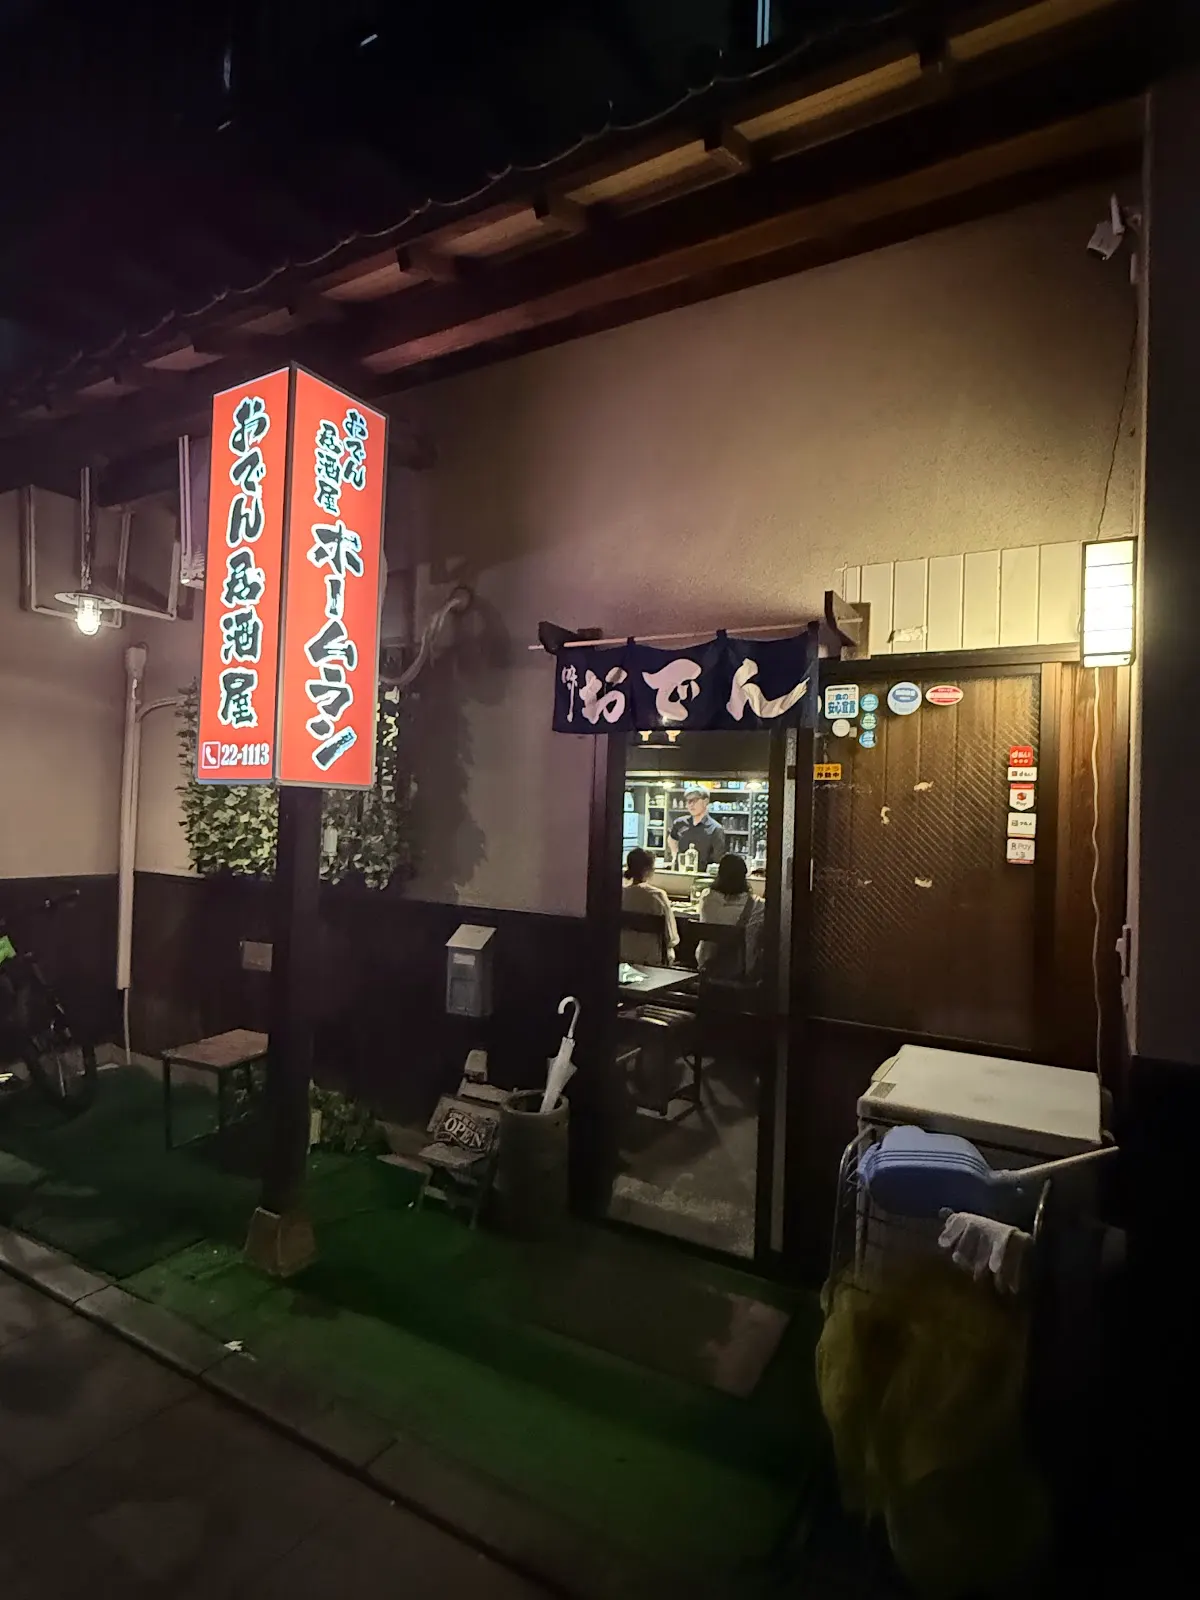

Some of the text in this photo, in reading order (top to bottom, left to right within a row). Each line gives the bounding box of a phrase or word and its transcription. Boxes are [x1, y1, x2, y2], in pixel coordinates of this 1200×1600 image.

[314, 419, 344, 516] 居酒屋
[342, 408, 368, 491] おでん
[306, 519, 365, 771] ホームラン
[579, 658, 811, 724] おでん
[220, 742, 270, 766] 22-1113
[444, 1117, 484, 1148] OPEN
